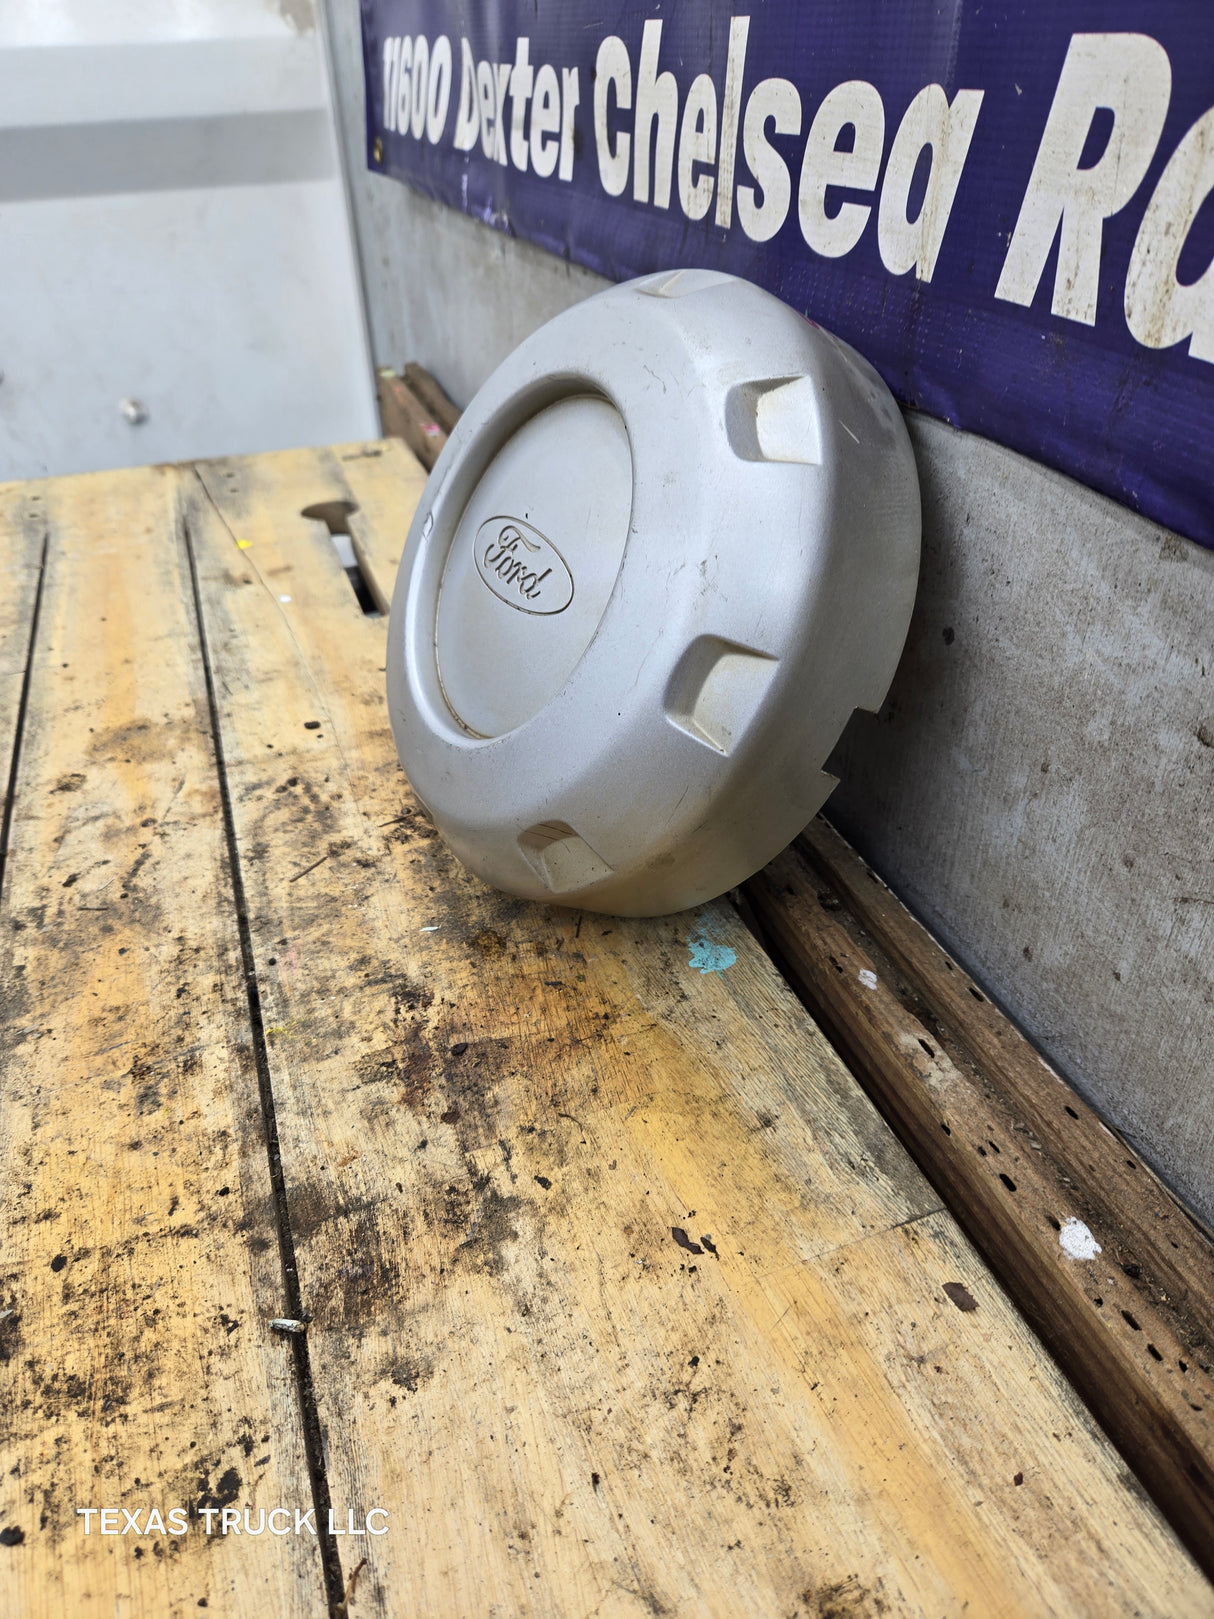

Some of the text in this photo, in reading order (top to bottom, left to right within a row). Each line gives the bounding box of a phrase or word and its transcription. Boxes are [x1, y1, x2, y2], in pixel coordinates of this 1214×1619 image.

[382, 35, 452, 145] 11600
[454, 37, 580, 182] Dexter
[594, 15, 984, 284] Chelsea
[484, 525, 553, 600] Ford
